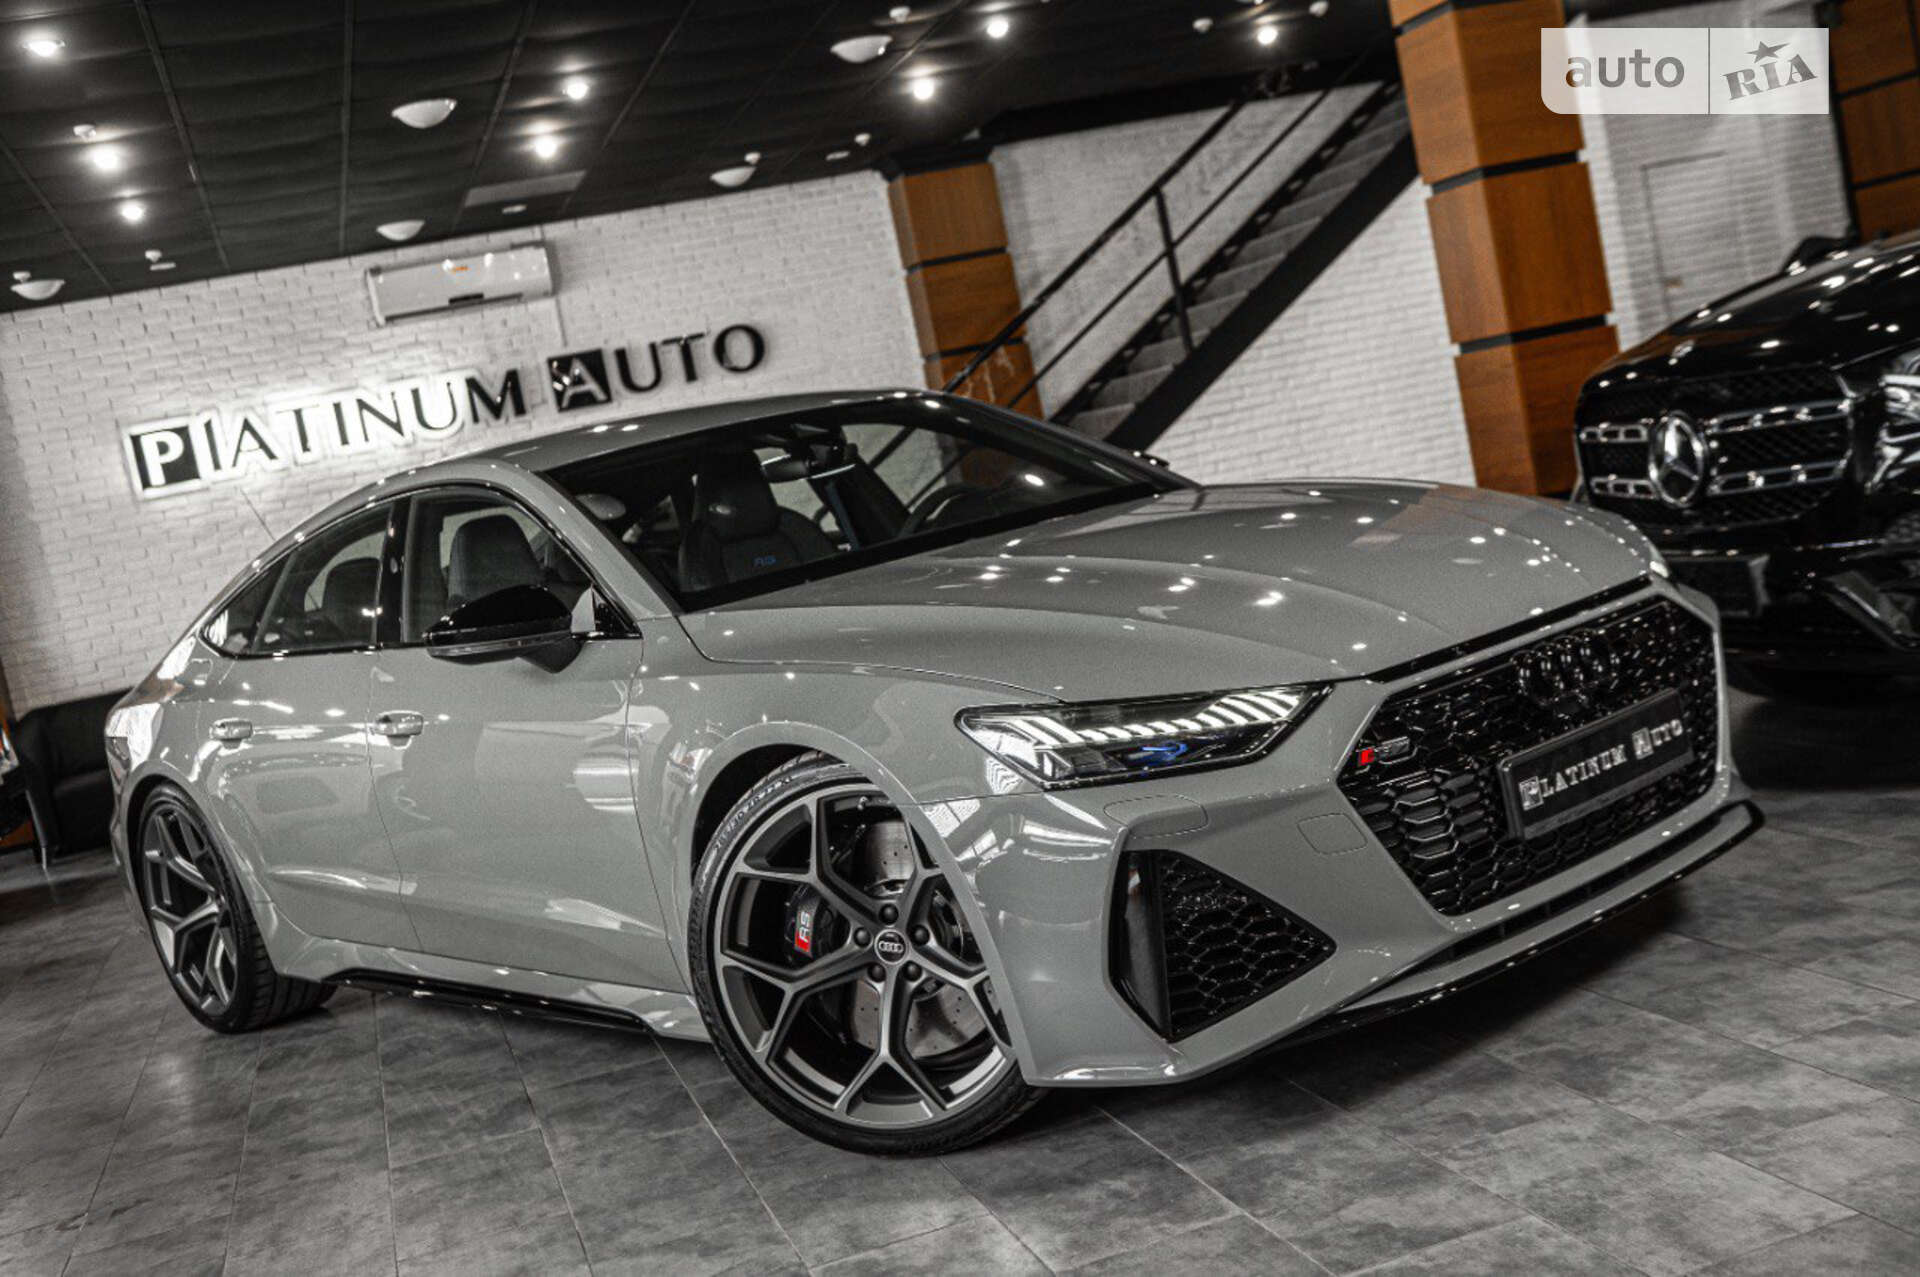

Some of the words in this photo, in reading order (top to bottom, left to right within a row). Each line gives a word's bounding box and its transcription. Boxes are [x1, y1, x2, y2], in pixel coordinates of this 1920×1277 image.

[547, 323, 766, 412] AUTO
[1519, 744, 1626, 811] PLATINUM
[1632, 718, 1684, 760] AUTO
[799, 911, 810, 943] RS
